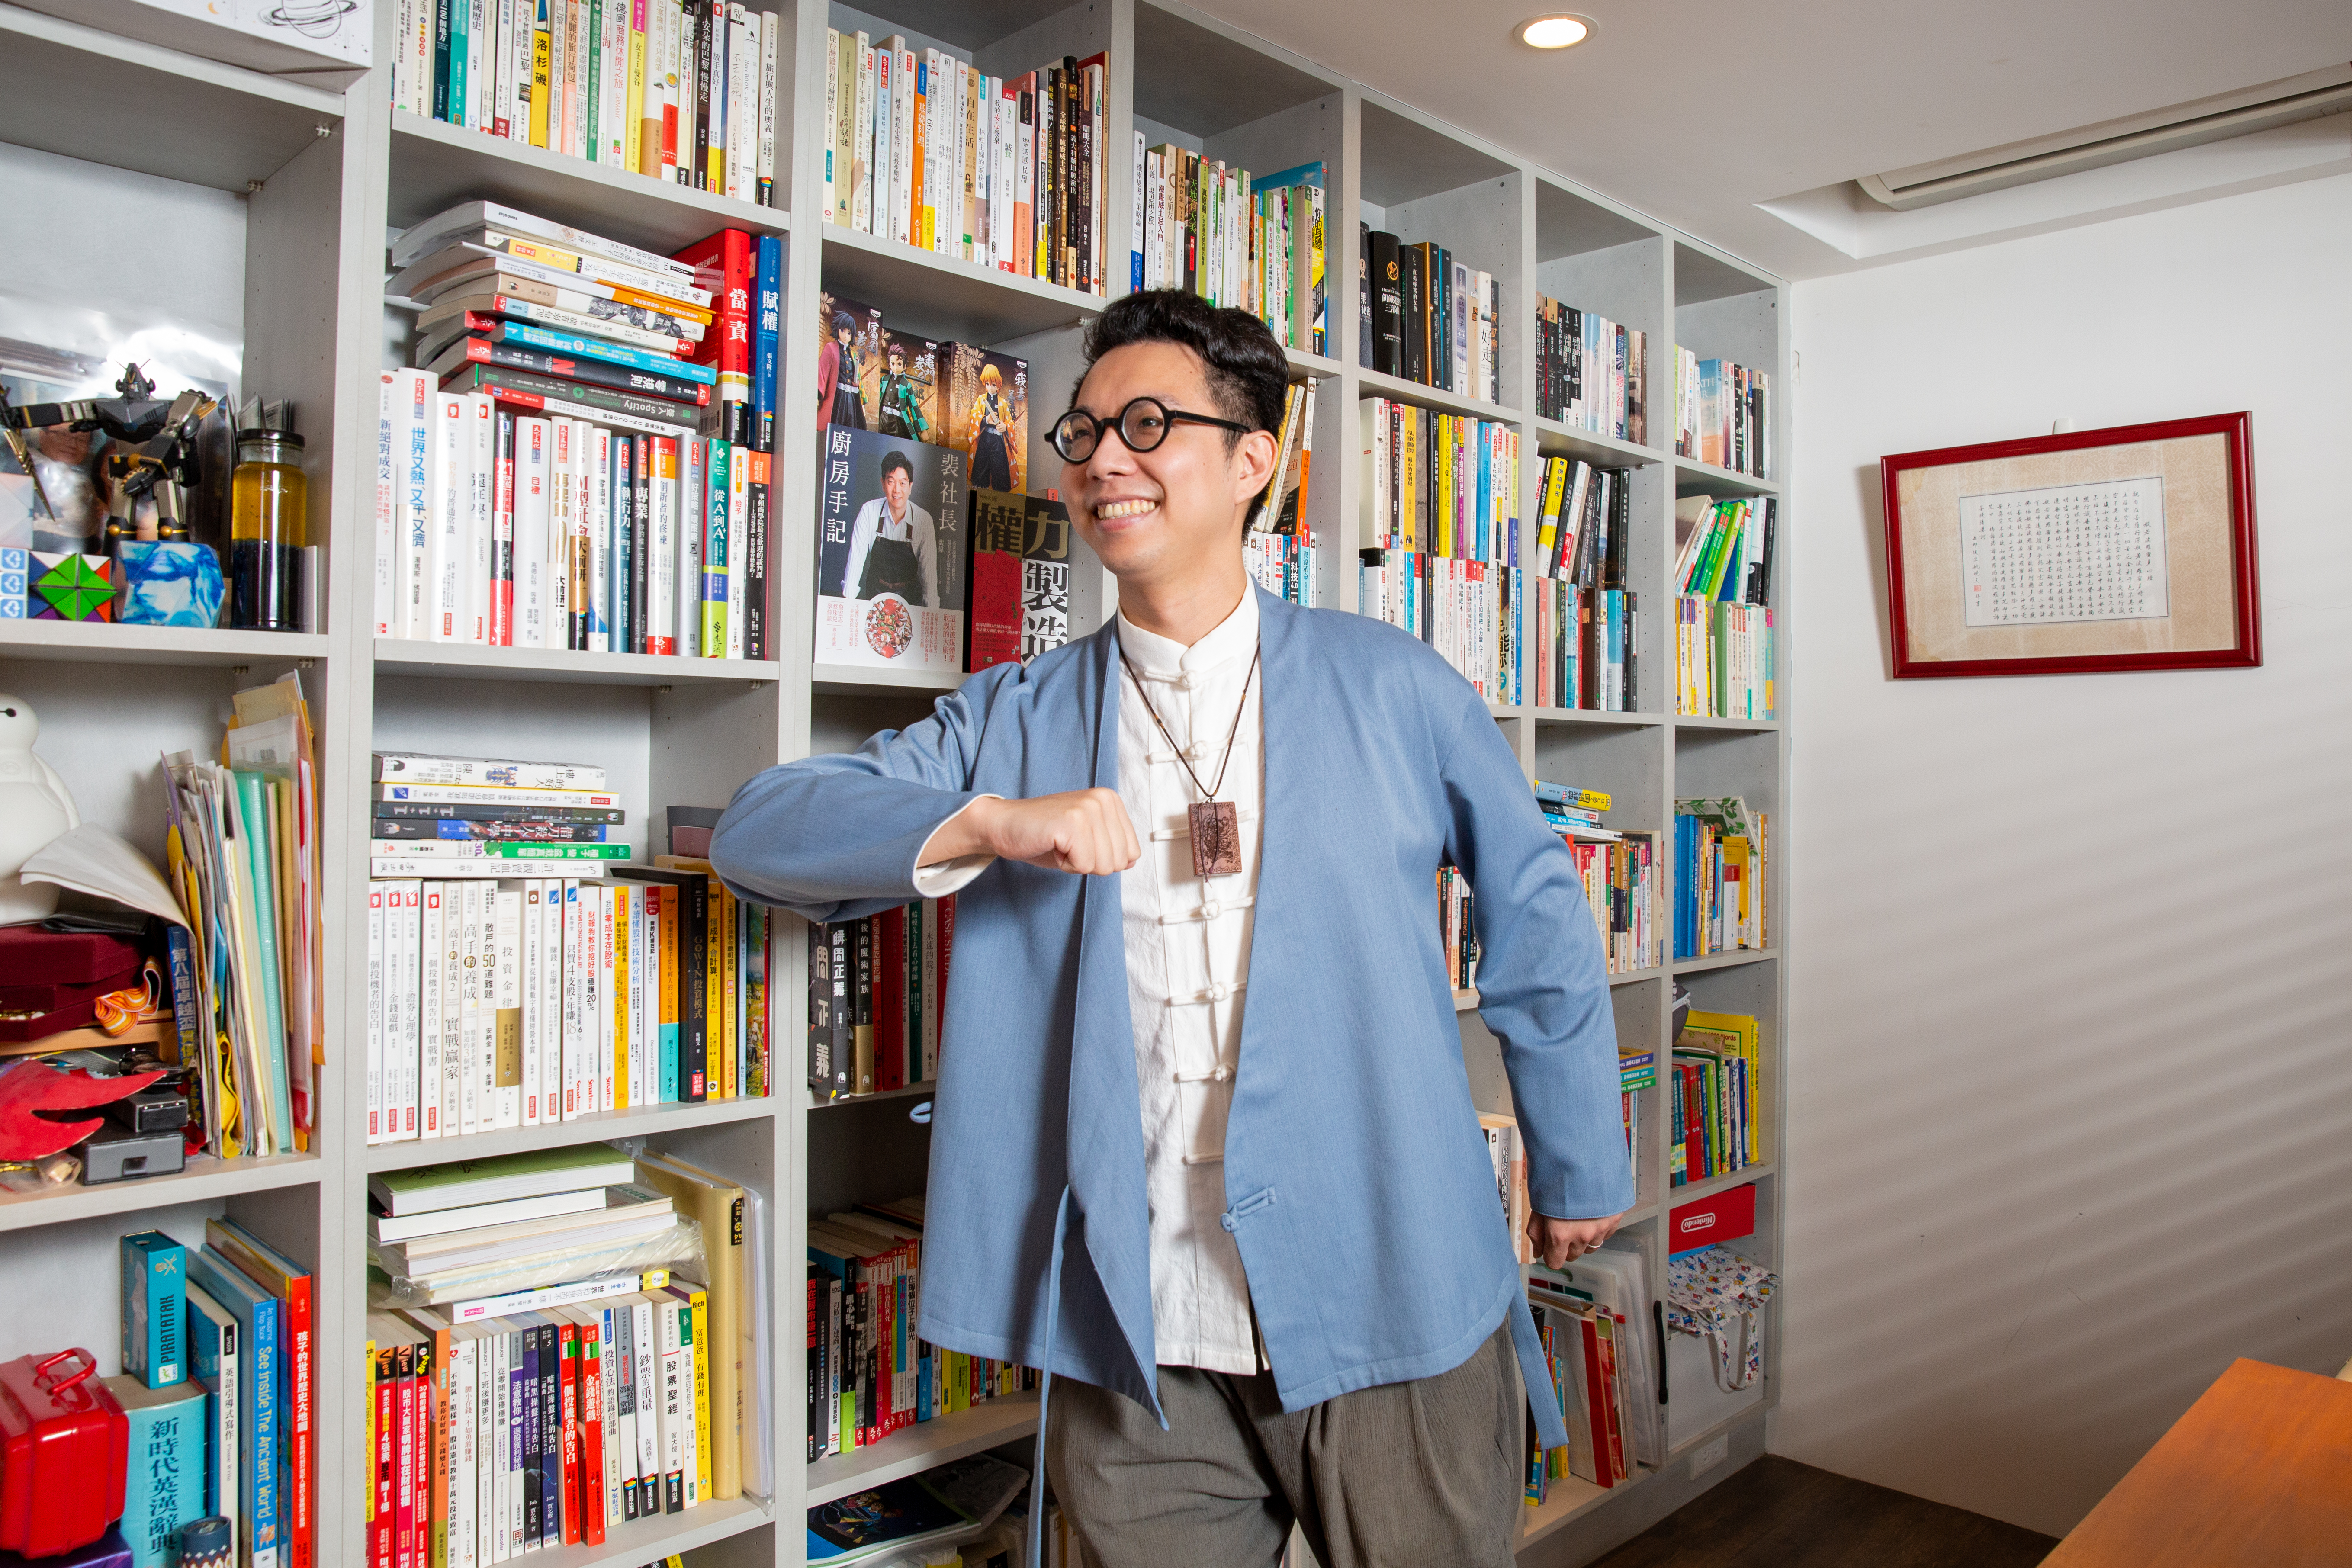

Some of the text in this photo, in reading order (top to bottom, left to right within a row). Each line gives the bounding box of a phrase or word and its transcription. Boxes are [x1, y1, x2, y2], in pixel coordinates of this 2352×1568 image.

[535, 39, 547, 86] 洛杉磯
[567, 12, 577, 83] 美麗的旅行荷包
[578, 15, 588, 94] 往天涯的盡頭單飛
[602, 23, 610, 49] 上海
[614, 2, 627, 89] 德國商務休閒之旅
[700, 71, 709, 102] 慢慢走
[764, 63, 774, 134] 旅行與人生的奧義
[827, 33, 837, 112] 從台灣諺語看台灣歷史
[917, 102, 925, 147] 基礎料理
[926, 119, 933, 131] 66
[966, 97, 974, 148] 自在生活
[938, 145, 945, 158] 科學
[945, 146, 951, 161] 料理
[1004, 143, 1012, 158] 誠食
[498, 211, 518, 220] suncolor
[1189, 178, 1198, 234] 天地有大美
[583, 263, 649, 287] 牧羊少年奇幻之旅
[536, 308, 578, 325] 記得你是誰
[728, 288, 747, 343] 當責
[762, 290, 778, 331] 賦權
[1385, 305, 1400, 315] 三部曲
[1482, 328, 1492, 363] 好走
[415, 379, 425, 404] 天下文化
[624, 400, 656, 414] Spotify
[631, 374, 666, 392] 零規則
[379, 418, 391, 479] 新絕對成交
[531, 476, 540, 495] 目標
[621, 486, 631, 528] 執行力
[634, 487, 649, 520] 專業
[735, 500, 742, 515] 給予
[826, 430, 852, 544] 廚房手記
[938, 452, 958, 533] 裴社長
[659, 481, 668, 545] 創新者的修練
[713, 489, 727, 539] 從A到A+
[975, 502, 1070, 559] 權力
[1290, 562, 1298, 581] 科技
[490, 864, 554, 874] 許三觀賣血記
[482, 923, 495, 999] 散戶的50道難題
[604, 900, 613, 969] 我的零成本存股術
[632, 895, 640, 984] 一本讀懂股票技術分析
[463, 923, 477, 1000] 高手的養成
[502, 947, 513, 1009] 投資金律
[833, 930, 845, 996] 瞬間正義
[369, 952, 380, 1029] 一個投機者的告白
[427, 952, 438, 1067] 一個投機者的告白 實戰書
[816, 922, 829, 1079] 間正義
[445, 1017, 459, 1080] 實戰贏家
[1684, 1215, 1714, 1229] Nintendo
[161, 1294, 175, 1363] PIRATATAK
[259, 1346, 272, 1369] See
[297, 1331, 308, 1432] 孩子的世界歷史大地圖
[604, 1349, 615, 1386] 投資心法
[639, 1353, 652, 1411] 鈔票的重量
[695, 1328, 704, 1397] 富爸爸，有錢有理
[225, 1368, 234, 1440] 英語引導式寫作
[482, 1372, 490, 1425] 下班後賺更多
[498, 1368, 506, 1427] 從零開始穩穩賺
[546, 1375, 556, 1453] 暗黑操盤手的告白
[586, 1375, 596, 1422] 金錢遊戲
[666, 1361, 677, 1415] 股票聖經
[259, 1411, 271, 1433] The
[530, 1377, 539, 1454] 暗黑操盤手的告白
[563, 1376, 576, 1463] 一個投機者的告白
[148, 1417, 178, 1554] 新時代英漢辭典
[259, 1436, 271, 1483] Ancient
[259, 1484, 272, 1518] World
